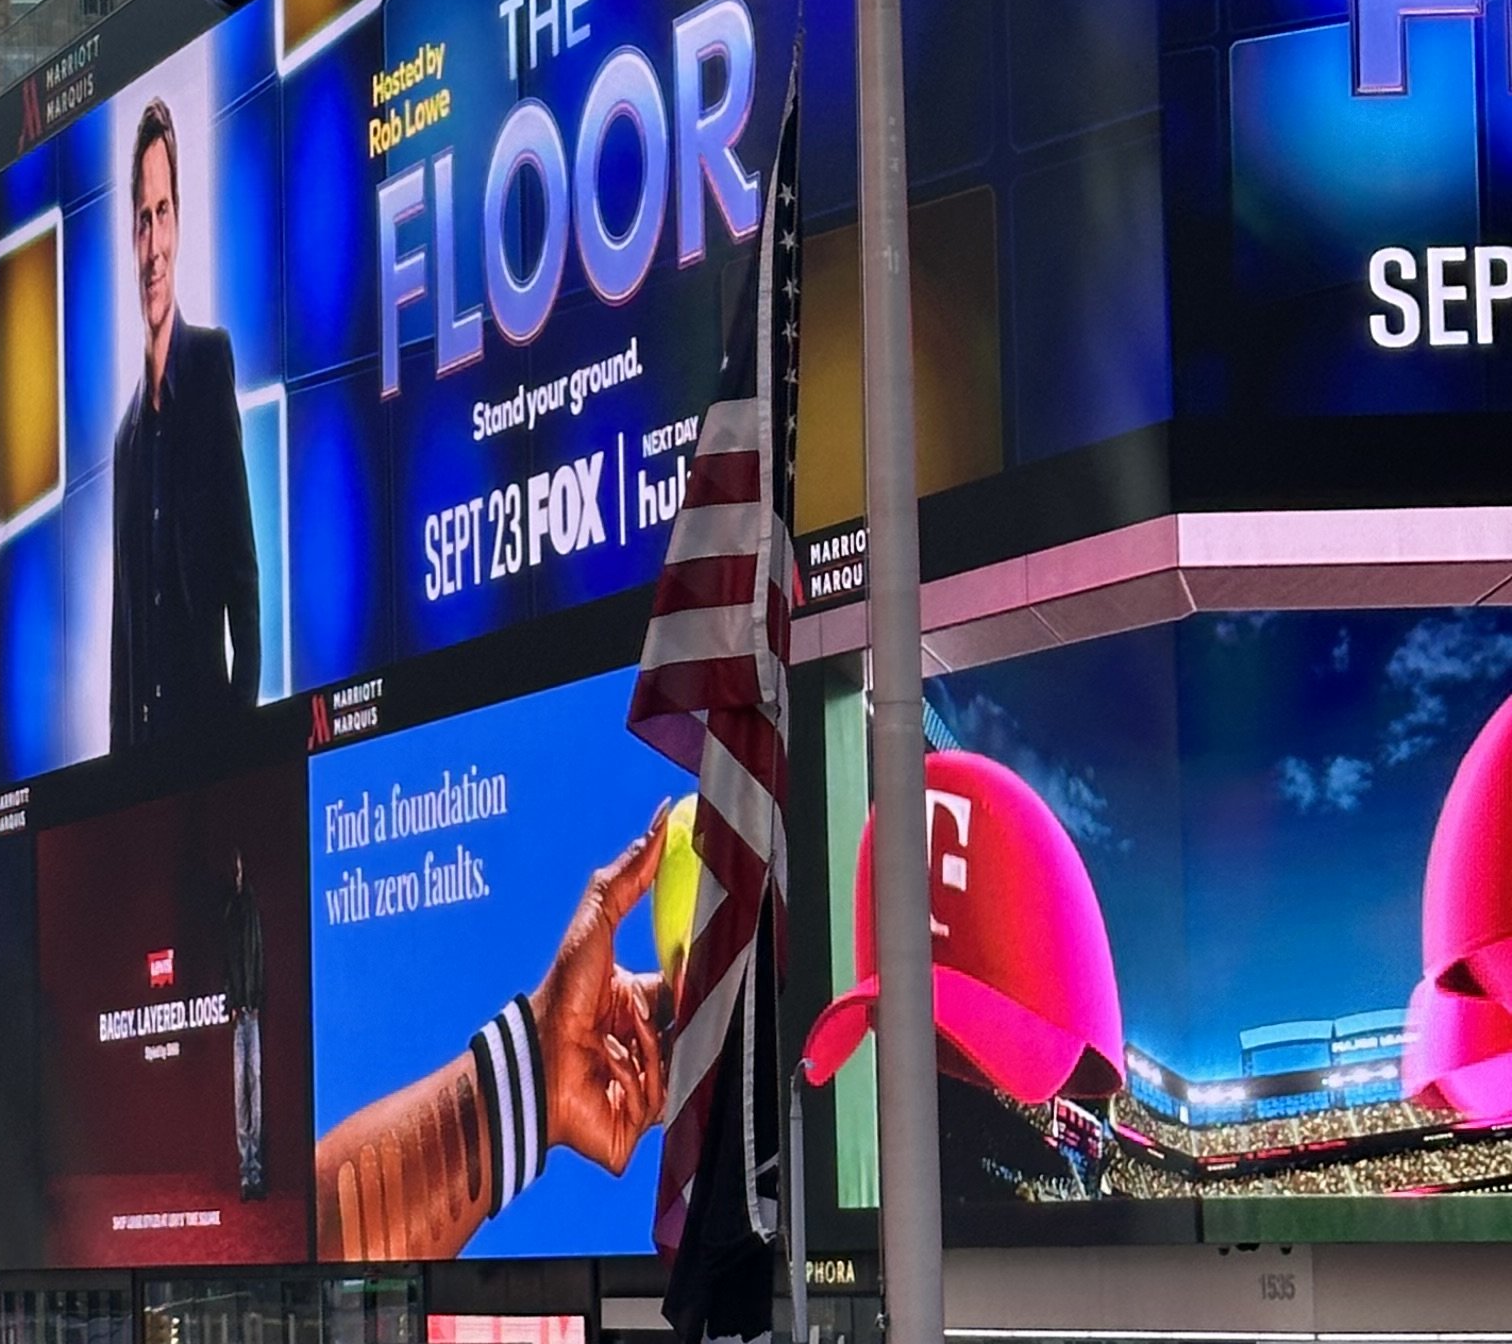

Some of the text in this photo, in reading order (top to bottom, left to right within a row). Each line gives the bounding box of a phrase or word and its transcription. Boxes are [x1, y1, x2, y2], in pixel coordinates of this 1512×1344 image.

[45, 34, 101, 91] MARRIOTT
[372, 42, 446, 107] Hosted by
[45, 72, 95, 124] MARQUIS
[368, 89, 451, 158] Rob Lowe
[1368, 245, 1512, 348] SEP
[472, 336, 643, 441] Stand your ground.
[642, 415, 699, 458] NEXT DAY
[527, 450, 607, 567] FOX
[638, 456, 691, 529] hul
[424, 483, 522, 602] SEPT 23
[809, 528, 870, 566] MARRIO
[810, 562, 863, 598] MARQU
[332, 677, 384, 710] MARRIOTT
[332, 705, 378, 736] MARQUIS
[324, 764, 508, 855] Find a foundation
[325, 843, 490, 926] with zero faults.
[99, 993, 230, 1042] BAGGY. LAYERED. LOOSE.
[789, 1259, 856, 1284] PHORA
